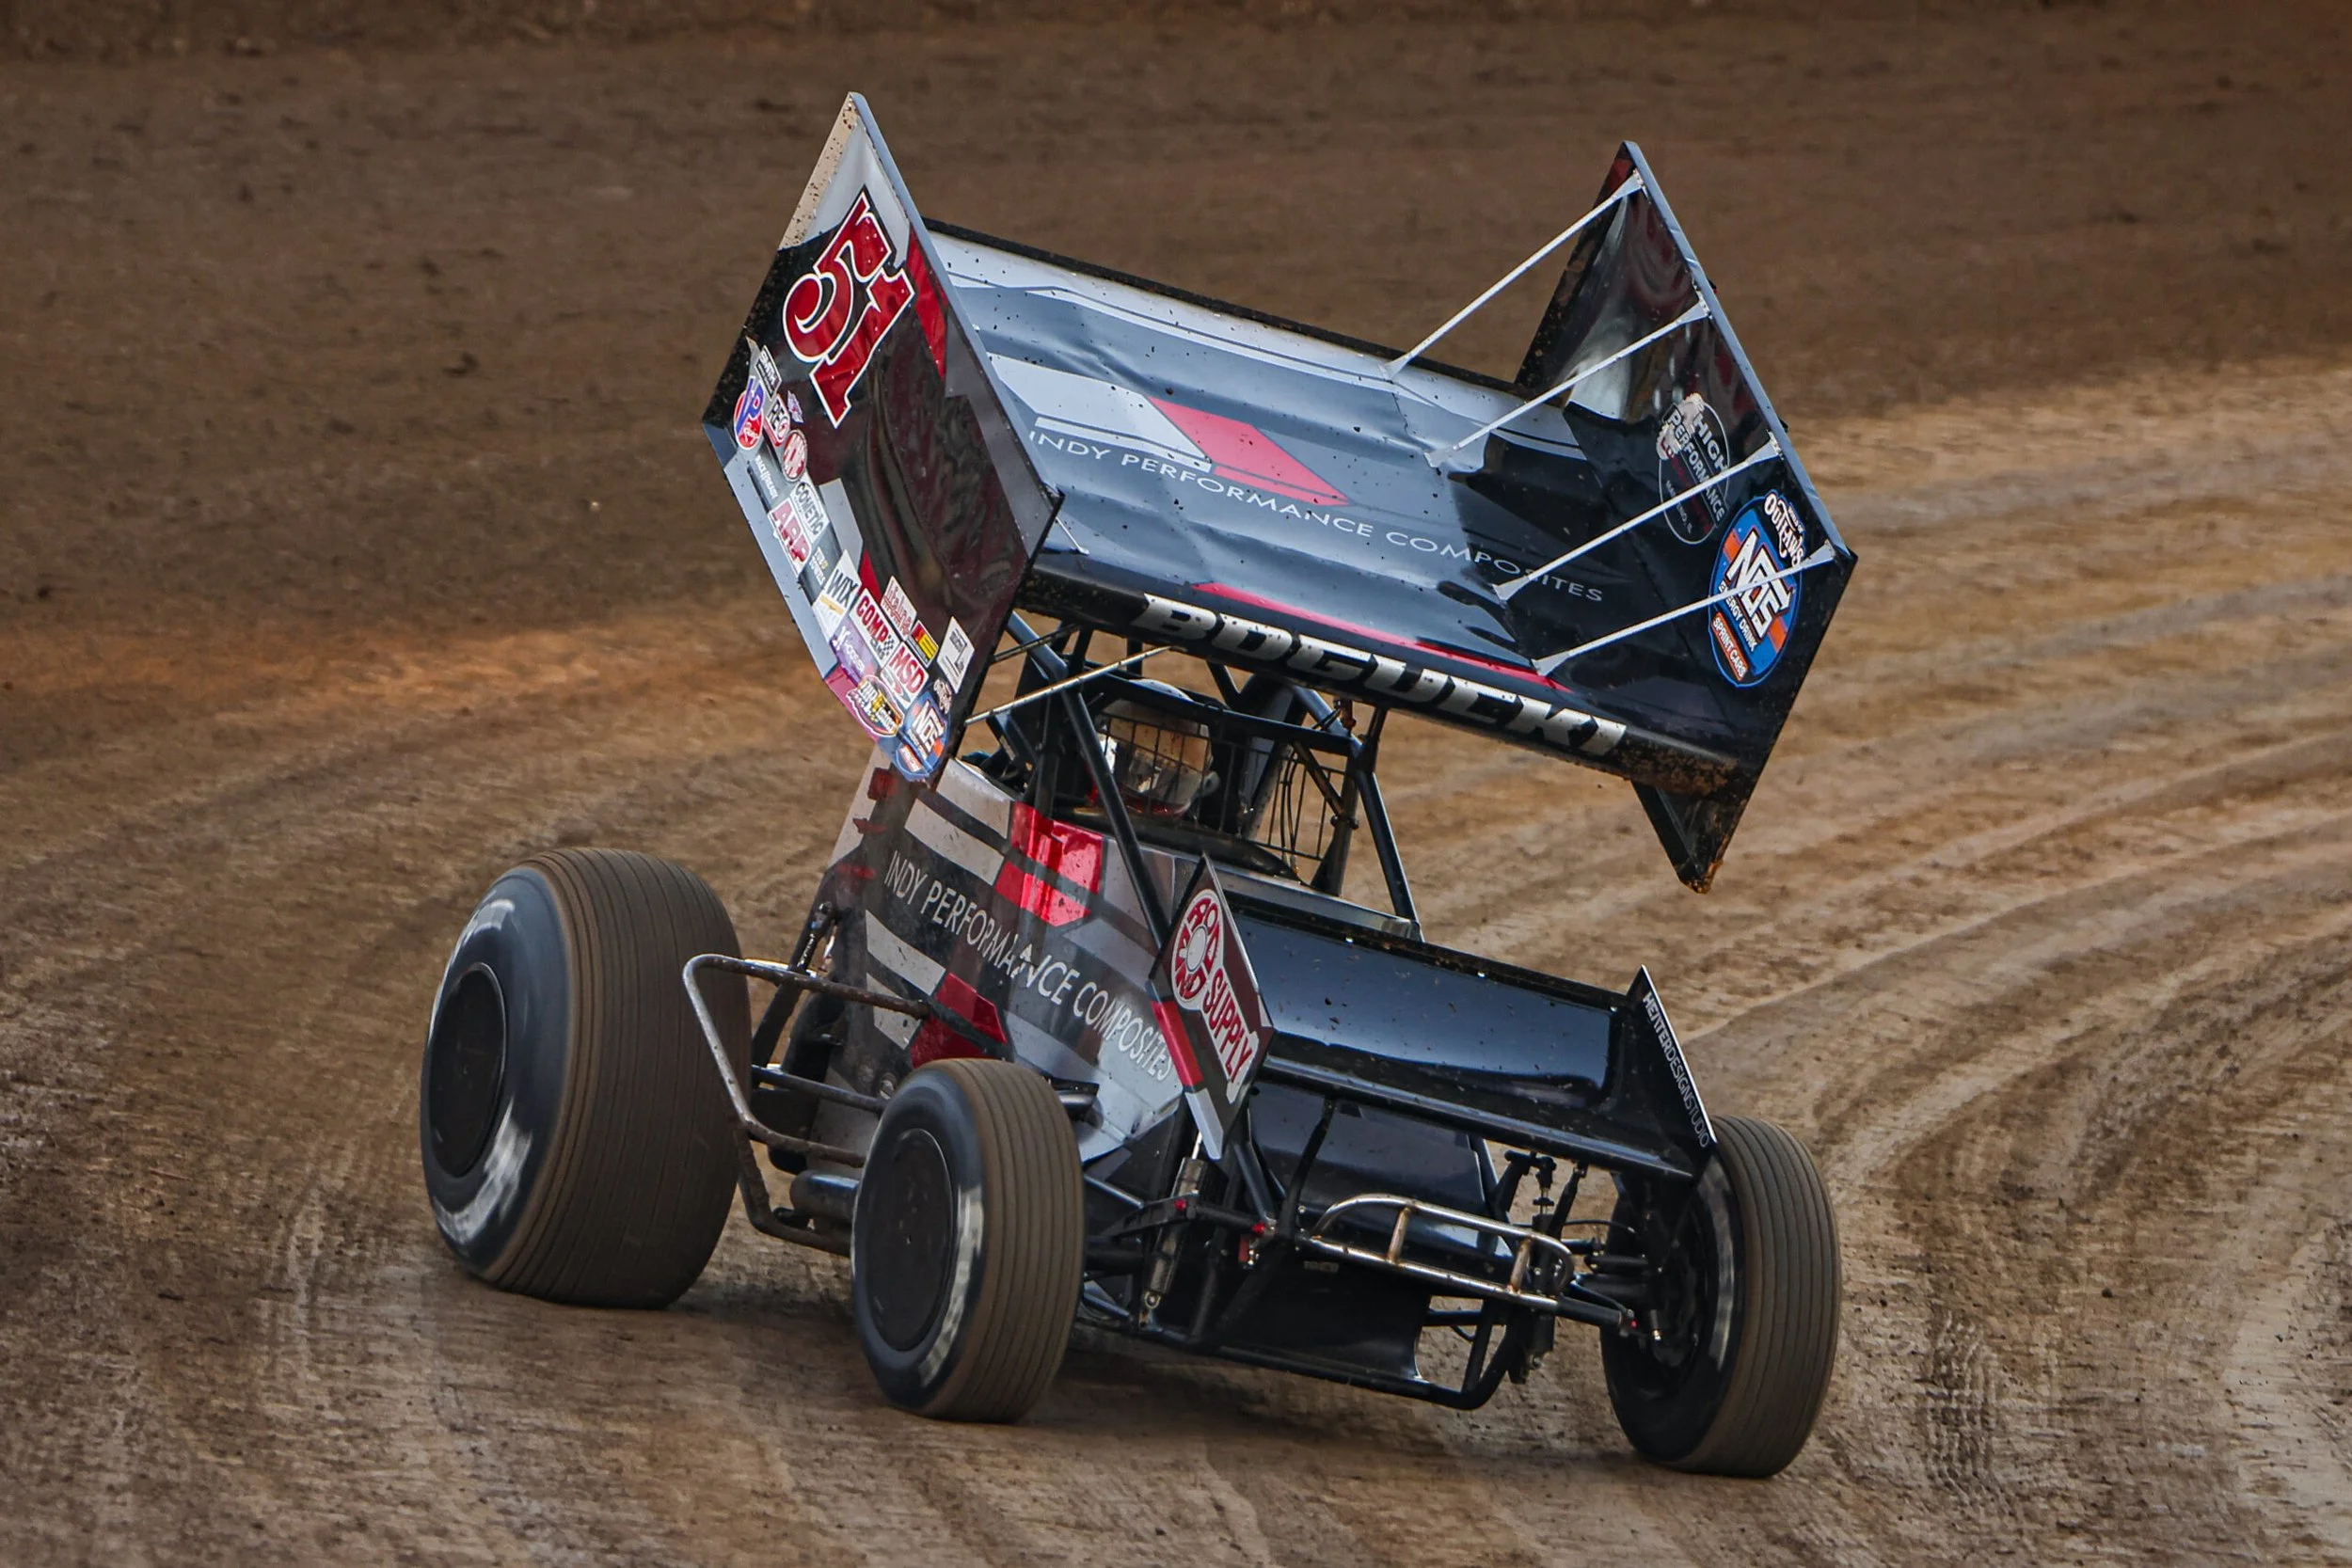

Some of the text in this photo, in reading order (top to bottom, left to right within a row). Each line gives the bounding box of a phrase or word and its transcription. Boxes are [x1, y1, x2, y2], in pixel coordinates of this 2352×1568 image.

[783, 188, 915, 430] 51
[1667, 408, 1725, 521] PERFORMANCE
[1693, 412, 1729, 472] HIGH
[794, 481, 824, 535] COMETIC
[1029, 430, 1111, 461] INDY
[1120, 452, 1374, 538] PERFORMANCE
[771, 499, 810, 562] ARP
[825, 568, 860, 609] WIX
[1724, 530, 1793, 640] NOS
[855, 594, 890, 643] COMP
[1712, 617, 1748, 678] SPRINT CARS
[1739, 618, 1759, 653] DRINK
[889, 646, 926, 694] MSD
[883, 850, 1175, 1082] INDY PERFORMANCE COMPOSITES
[1202, 967, 1253, 1083] SUPPLY
